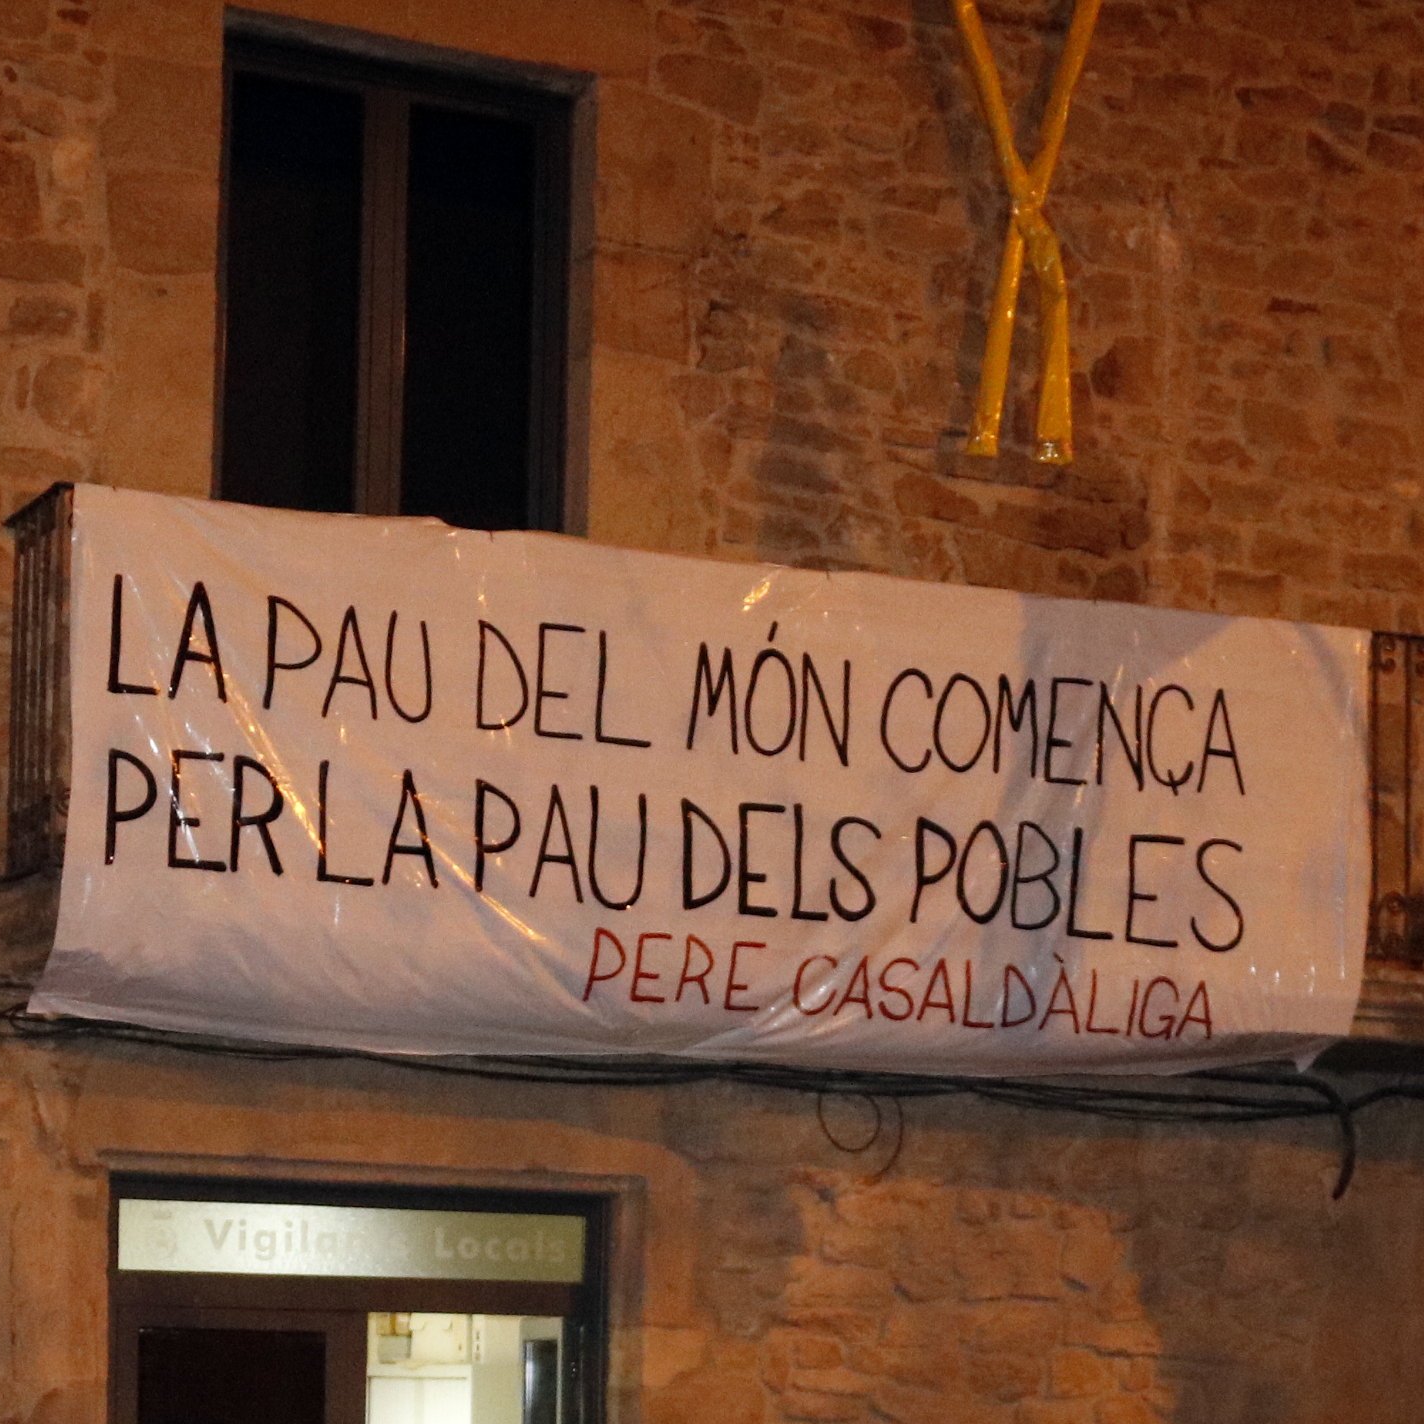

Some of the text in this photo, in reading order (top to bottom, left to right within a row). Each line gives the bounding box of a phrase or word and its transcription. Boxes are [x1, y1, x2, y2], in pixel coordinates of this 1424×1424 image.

[107, 574, 1245, 796] LA PAU DEL MÓN COMENÇA
[105, 748, 1245, 953] PER LA PAU DELS POBLES
[583, 927, 1213, 1039] PERE CASALDÀLIGA
[205, 1218, 567, 1264] Vigilans Locals
